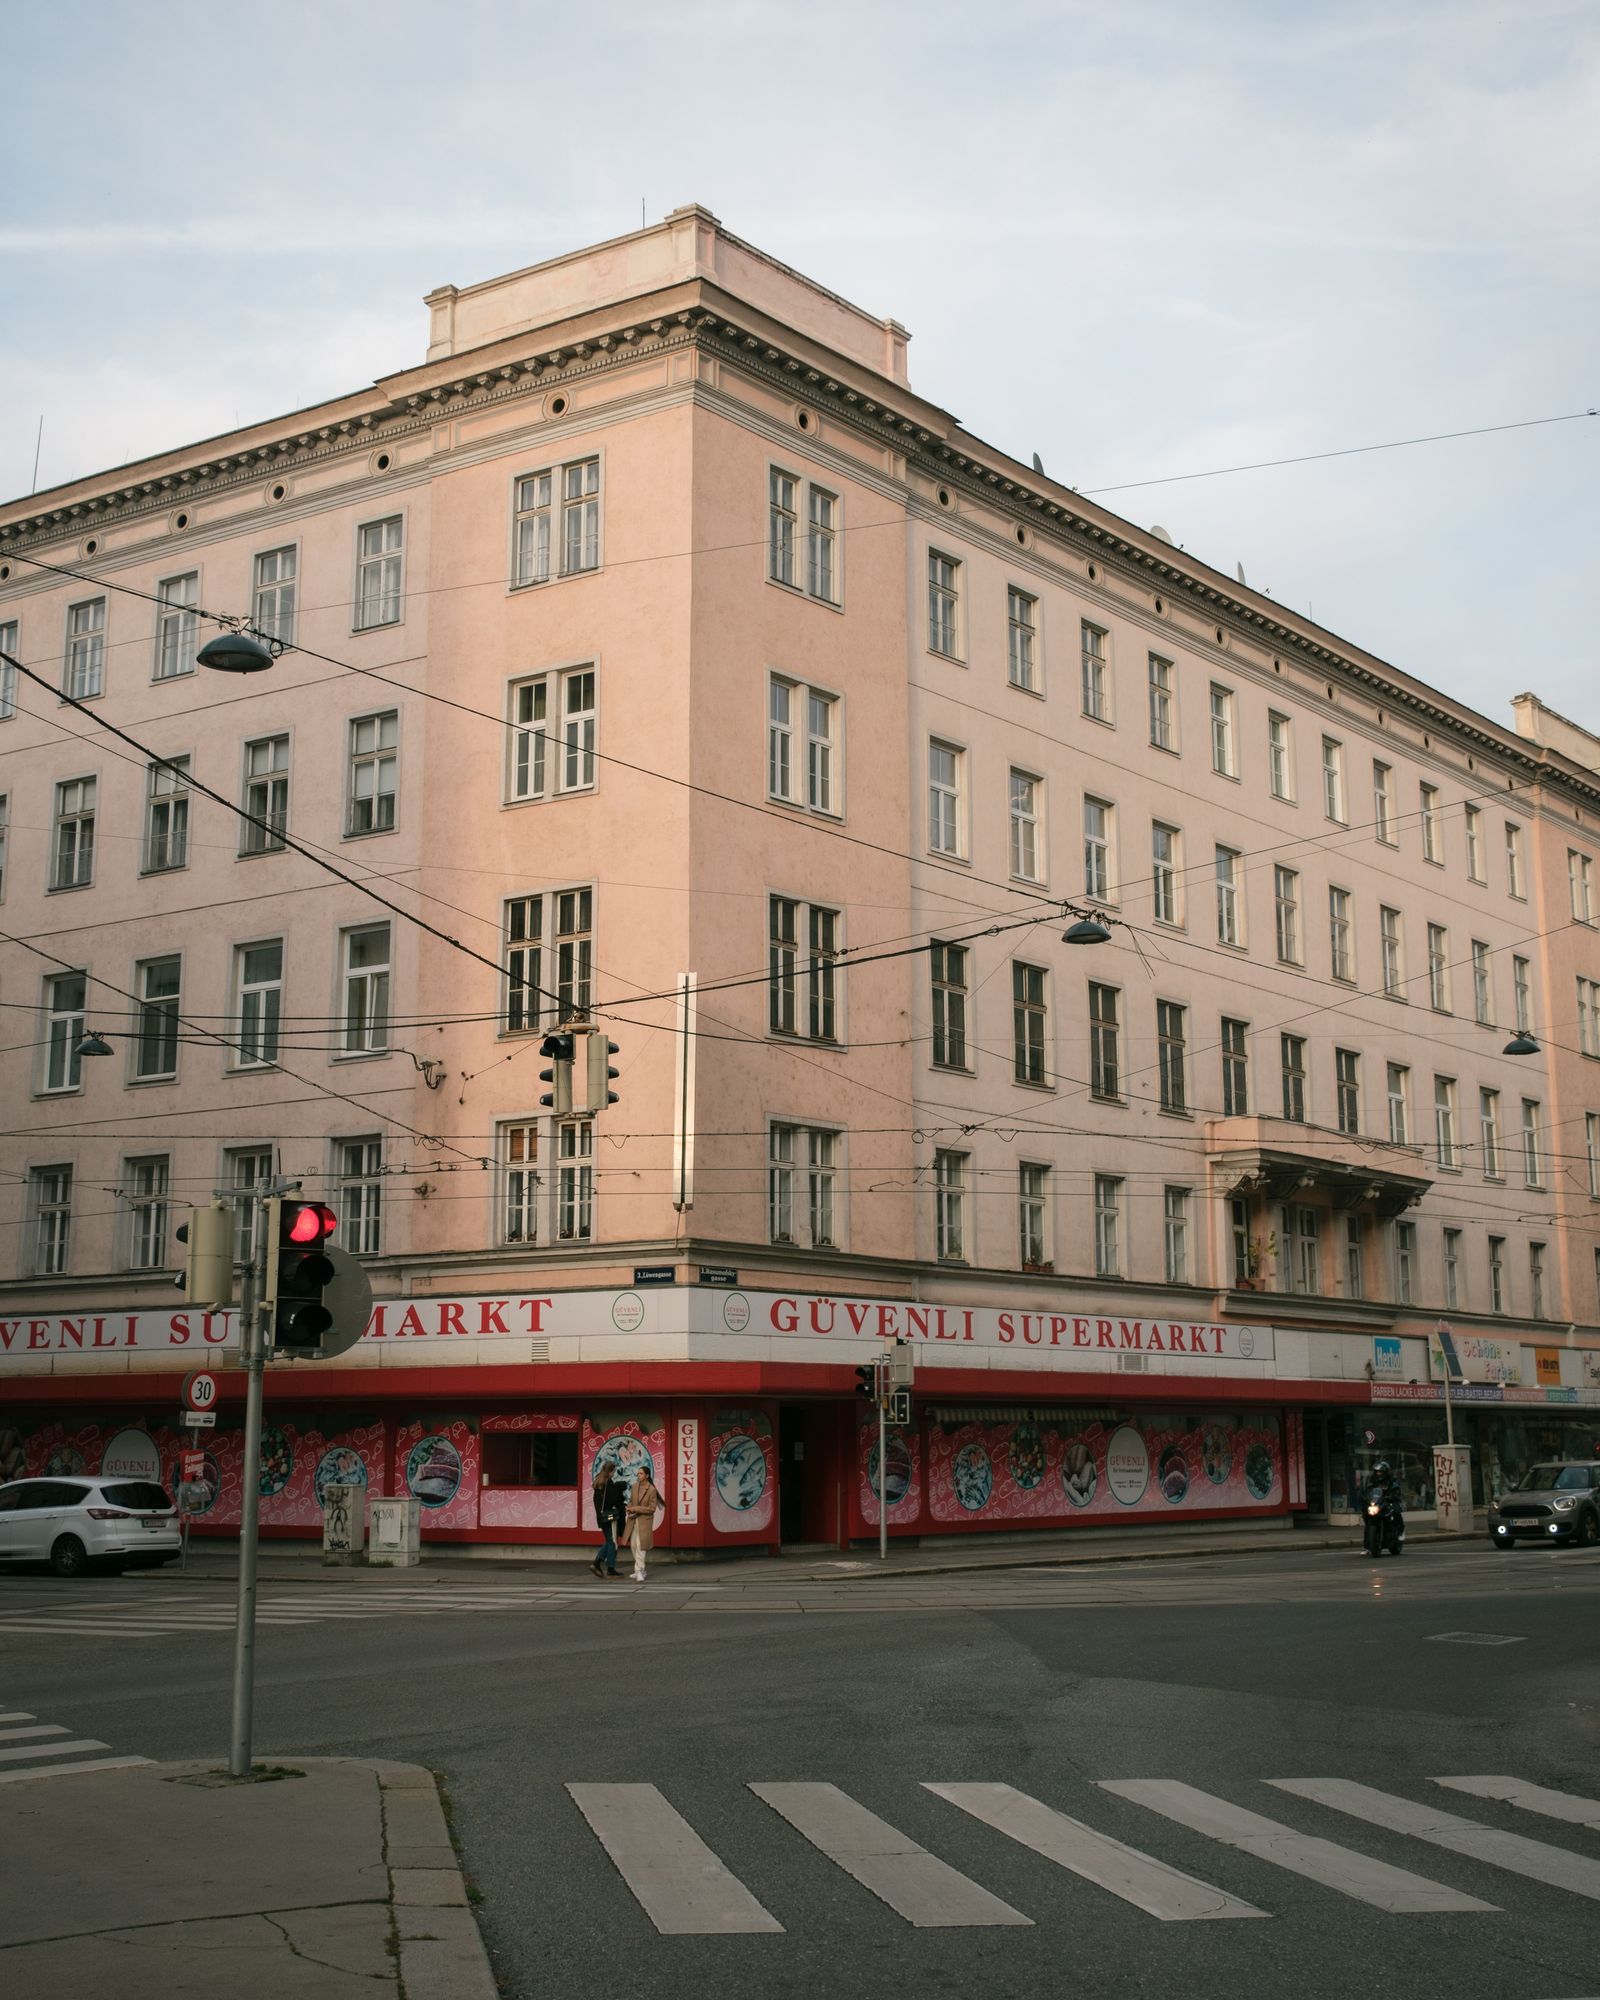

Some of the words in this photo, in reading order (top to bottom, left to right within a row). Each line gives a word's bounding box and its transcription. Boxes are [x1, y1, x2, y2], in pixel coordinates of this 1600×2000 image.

[770, 1298, 974, 1340] GÜVENLI
[998, 1313, 1227, 1353] SUPERMARKT
[195, 1381, 212, 1400] 30
[1373, 1386, 1395, 1397] FARBEN
[1396, 1387, 1413, 1398] LACKE
[1414, 1387, 1437, 1398] LASUREN
[107, 1459, 155, 1472] GÜVENLI
[1110, 1455, 1145, 1466] GÜVENLI
[682, 1424, 694, 1515] GÜVENLI
